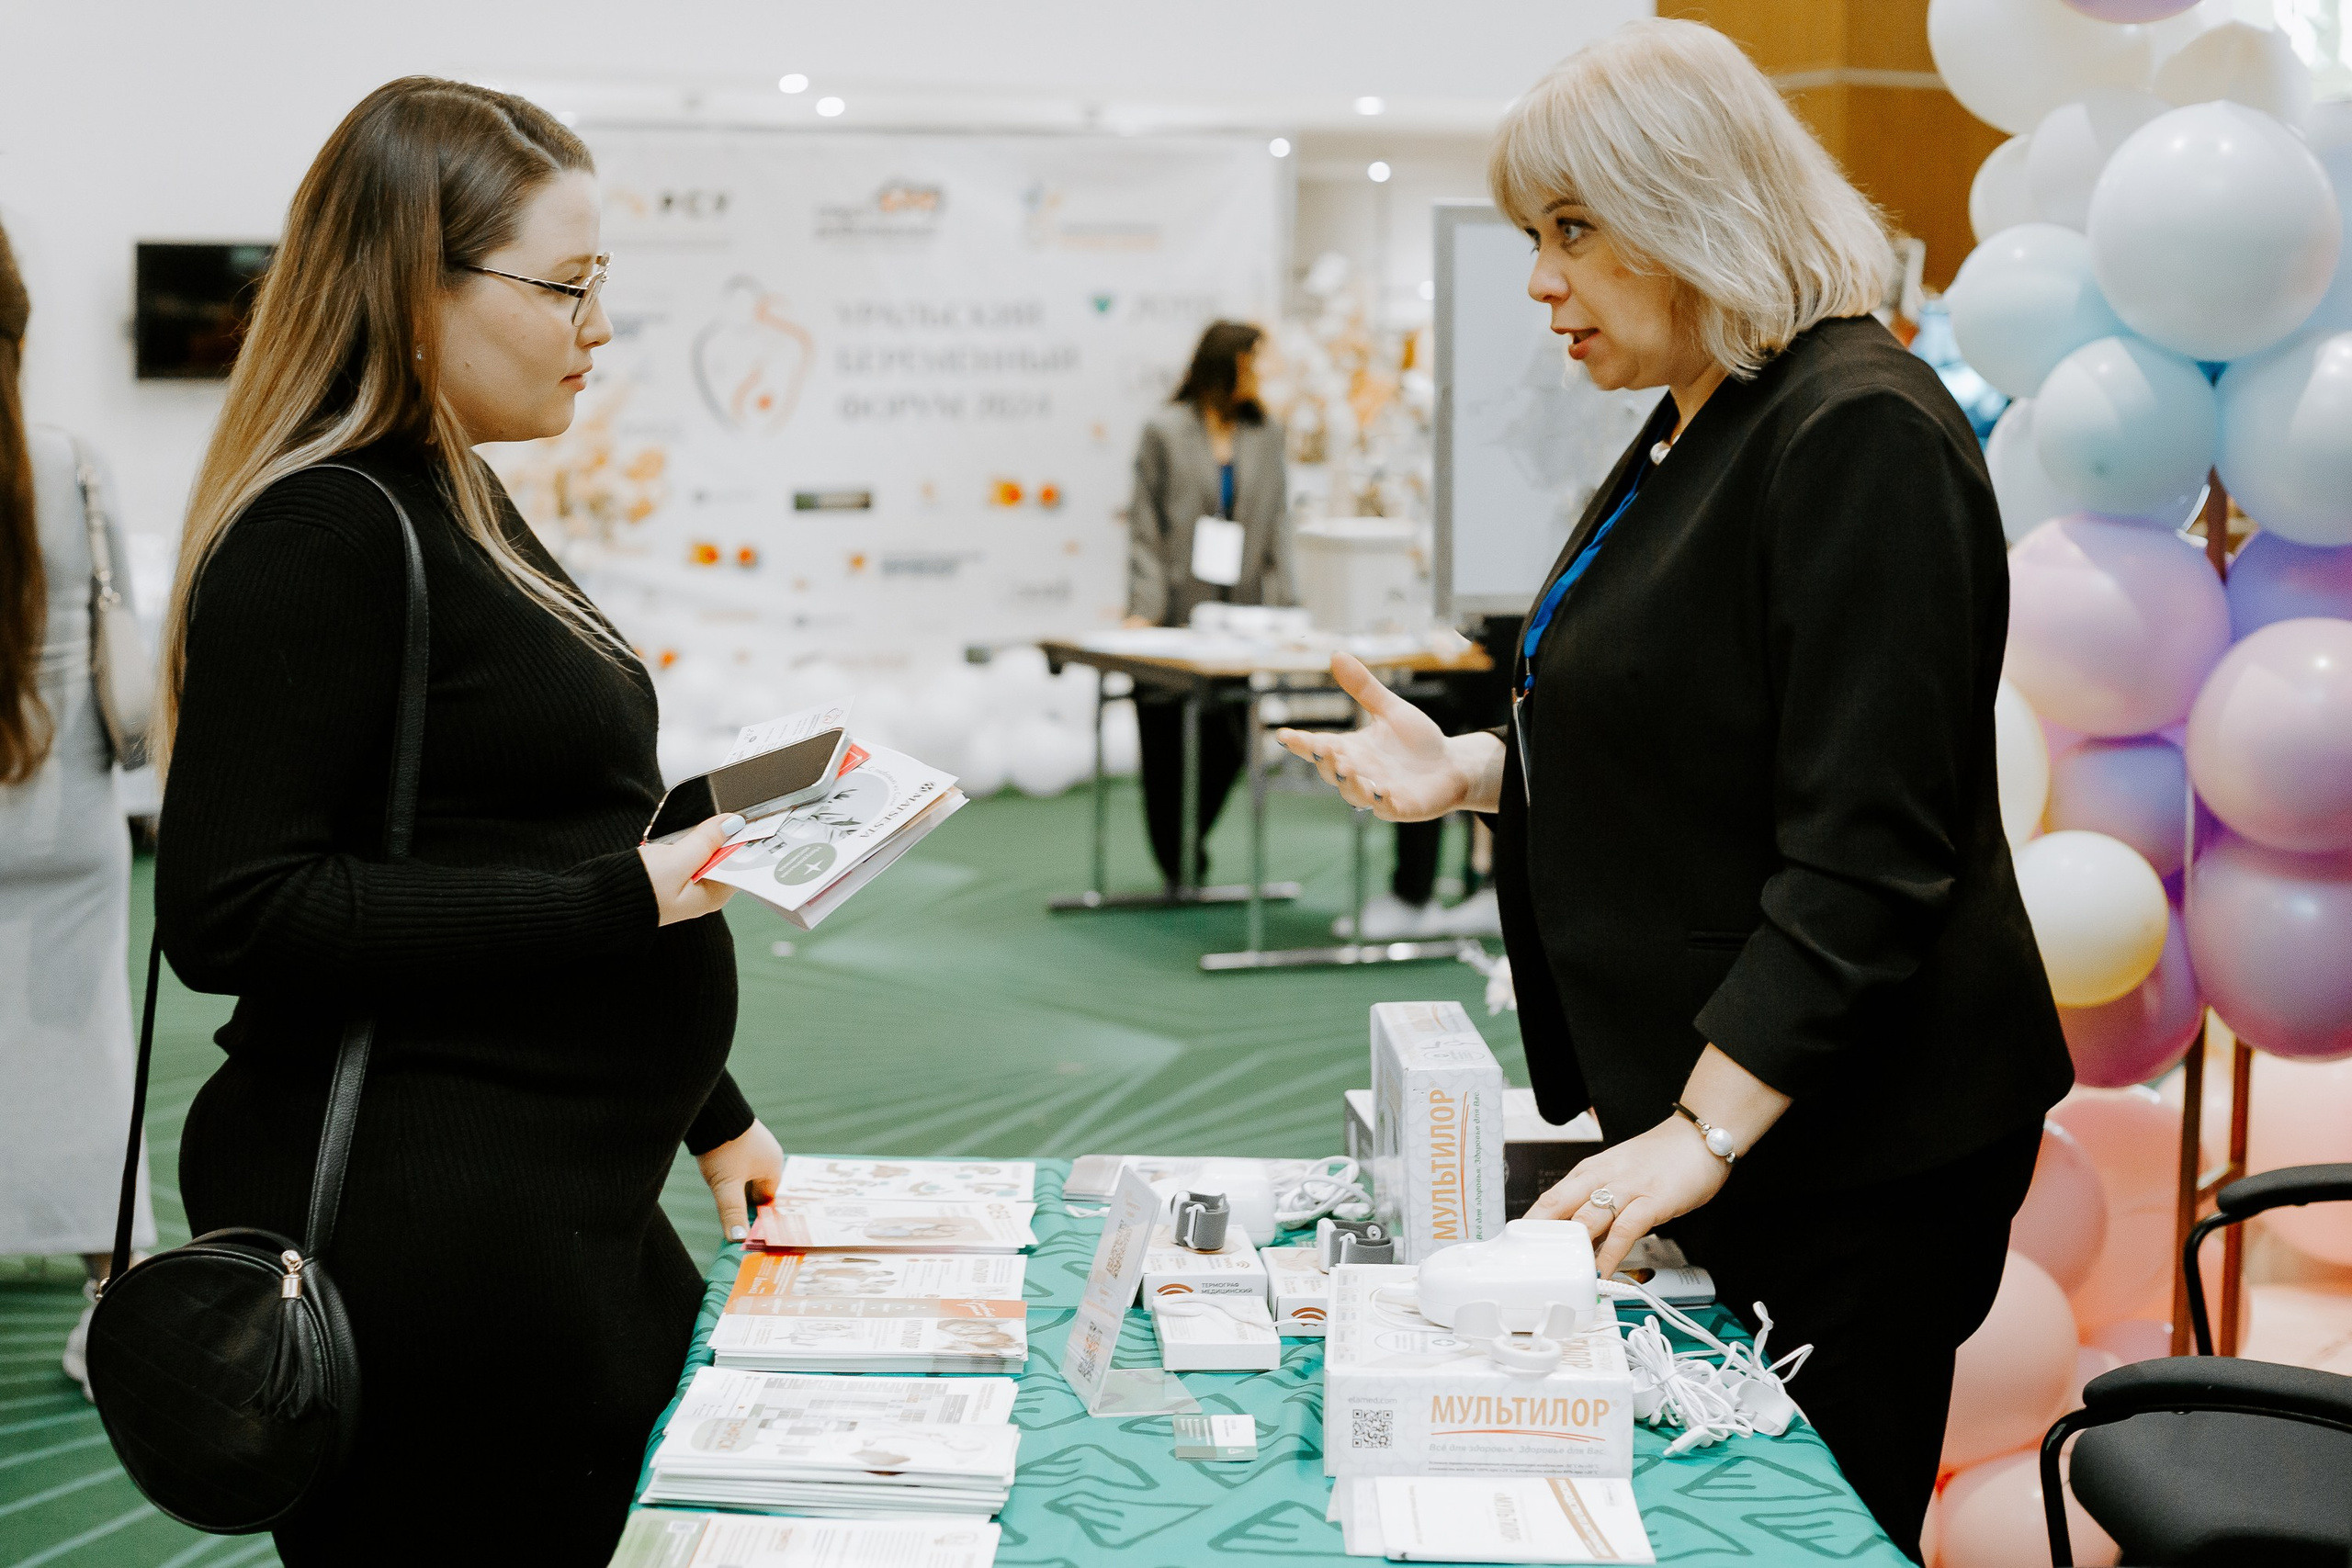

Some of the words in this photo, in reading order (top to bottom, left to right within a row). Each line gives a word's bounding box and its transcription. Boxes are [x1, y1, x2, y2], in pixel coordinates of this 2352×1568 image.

[1430, 1089, 1459, 1240] МУЛЬТИЛОР
[1348, 1396, 1397, 1404] elamed.com
[1430, 1395, 1610, 1427] МУЛЬТИЛОР
[1519, 1446, 1565, 1454] Здоровье
